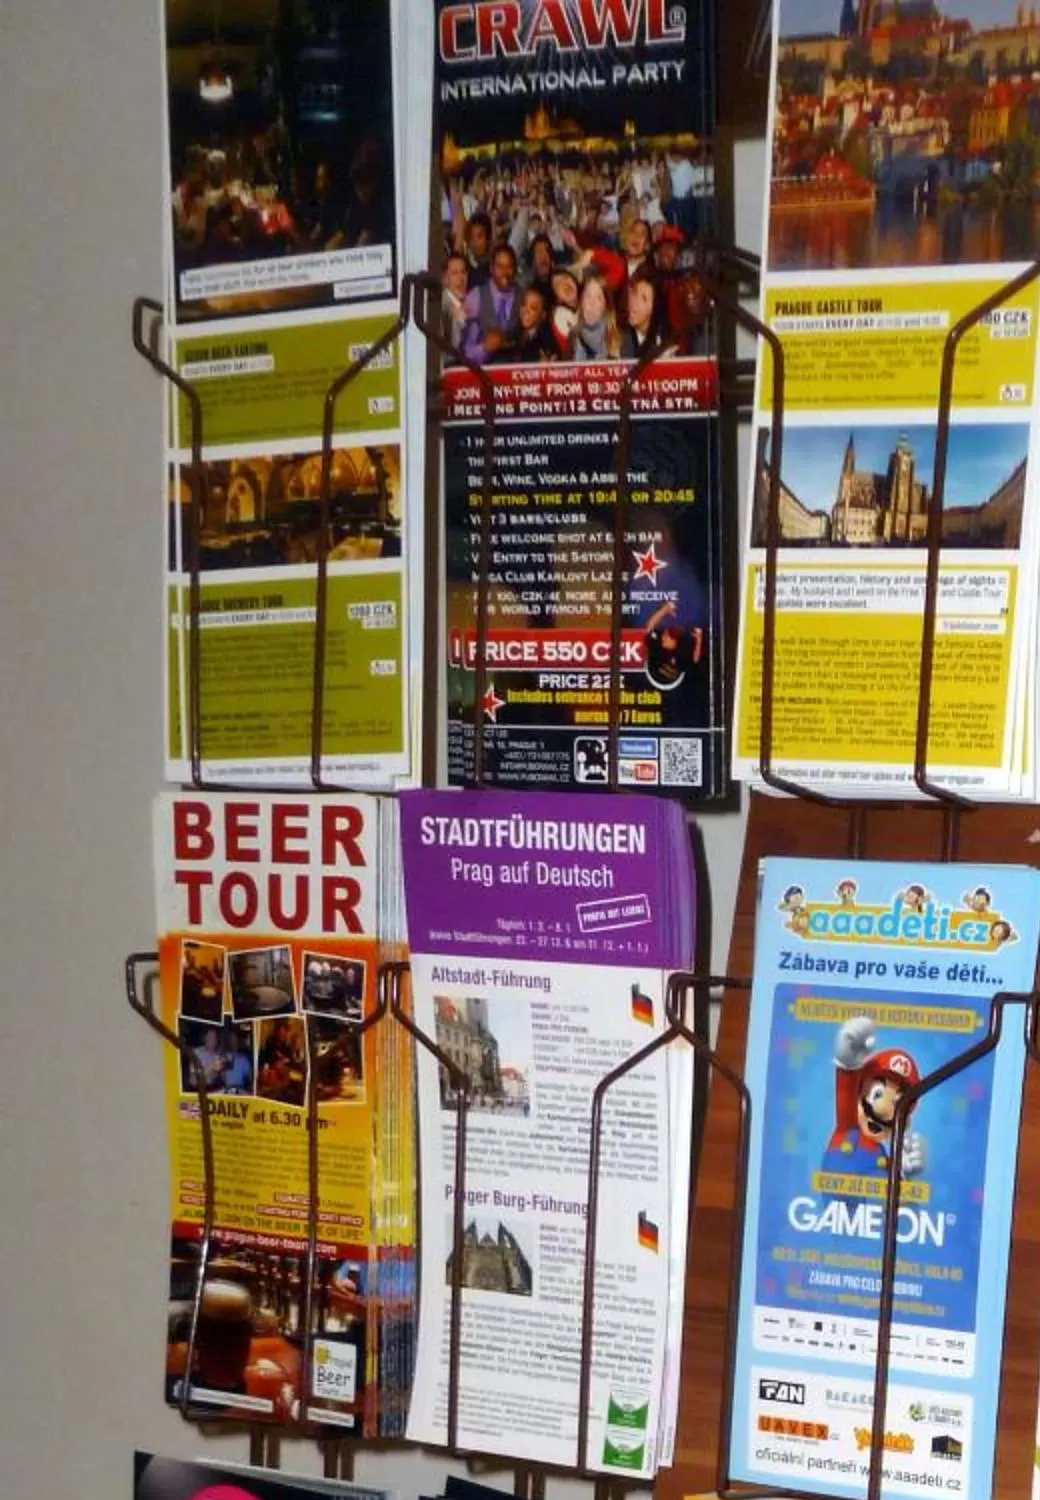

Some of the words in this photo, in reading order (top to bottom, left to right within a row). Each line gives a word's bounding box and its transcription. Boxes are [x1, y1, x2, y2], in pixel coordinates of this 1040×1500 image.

[441, 66, 605, 101] INTERNATIONAL
[612, 60, 686, 87] PARTY
[775, 299, 813, 315] PRAGUE
[816, 297, 852, 314] CASTLE
[856, 297, 883, 313] TOUR
[454, 387, 481, 400] JOIN
[547, 381, 583, 396] FROM
[507, 433, 565, 448] UNLIMITED
[567, 433, 609, 446] DRINKS
[525, 454, 549, 466] BAR
[567, 492, 583, 505] AT
[653, 488, 696, 503] 20:45
[543, 640, 587, 662] 550
[539, 673, 588, 689] PRICE
[173, 801, 366, 866] BEER
[420, 814, 646, 855] STADTFÜHRUNGEN
[451, 858, 493, 887] Prag
[500, 861, 529, 884] auf
[536, 862, 614, 888] Deutsch
[174, 870, 365, 934] TOUR
[808, 899, 990, 943] aaadeti.cz
[431, 966, 552, 992] Altstadt-Führung
[778, 951, 849, 974] Zábava
[855, 959, 887, 980] pro
[894, 961, 940, 981] vaše
[207, 1099, 250, 1120] DAILY
[253, 1110, 268, 1124] at
[270, 1110, 301, 1127] 6.30
[493, 1190, 590, 1219] Burg-Führung
[316, 1367, 351, 1388] Beer
[807, 1456, 857, 1475] partneři
[859, 1464, 962, 1491] ww.aaadeti.cz
